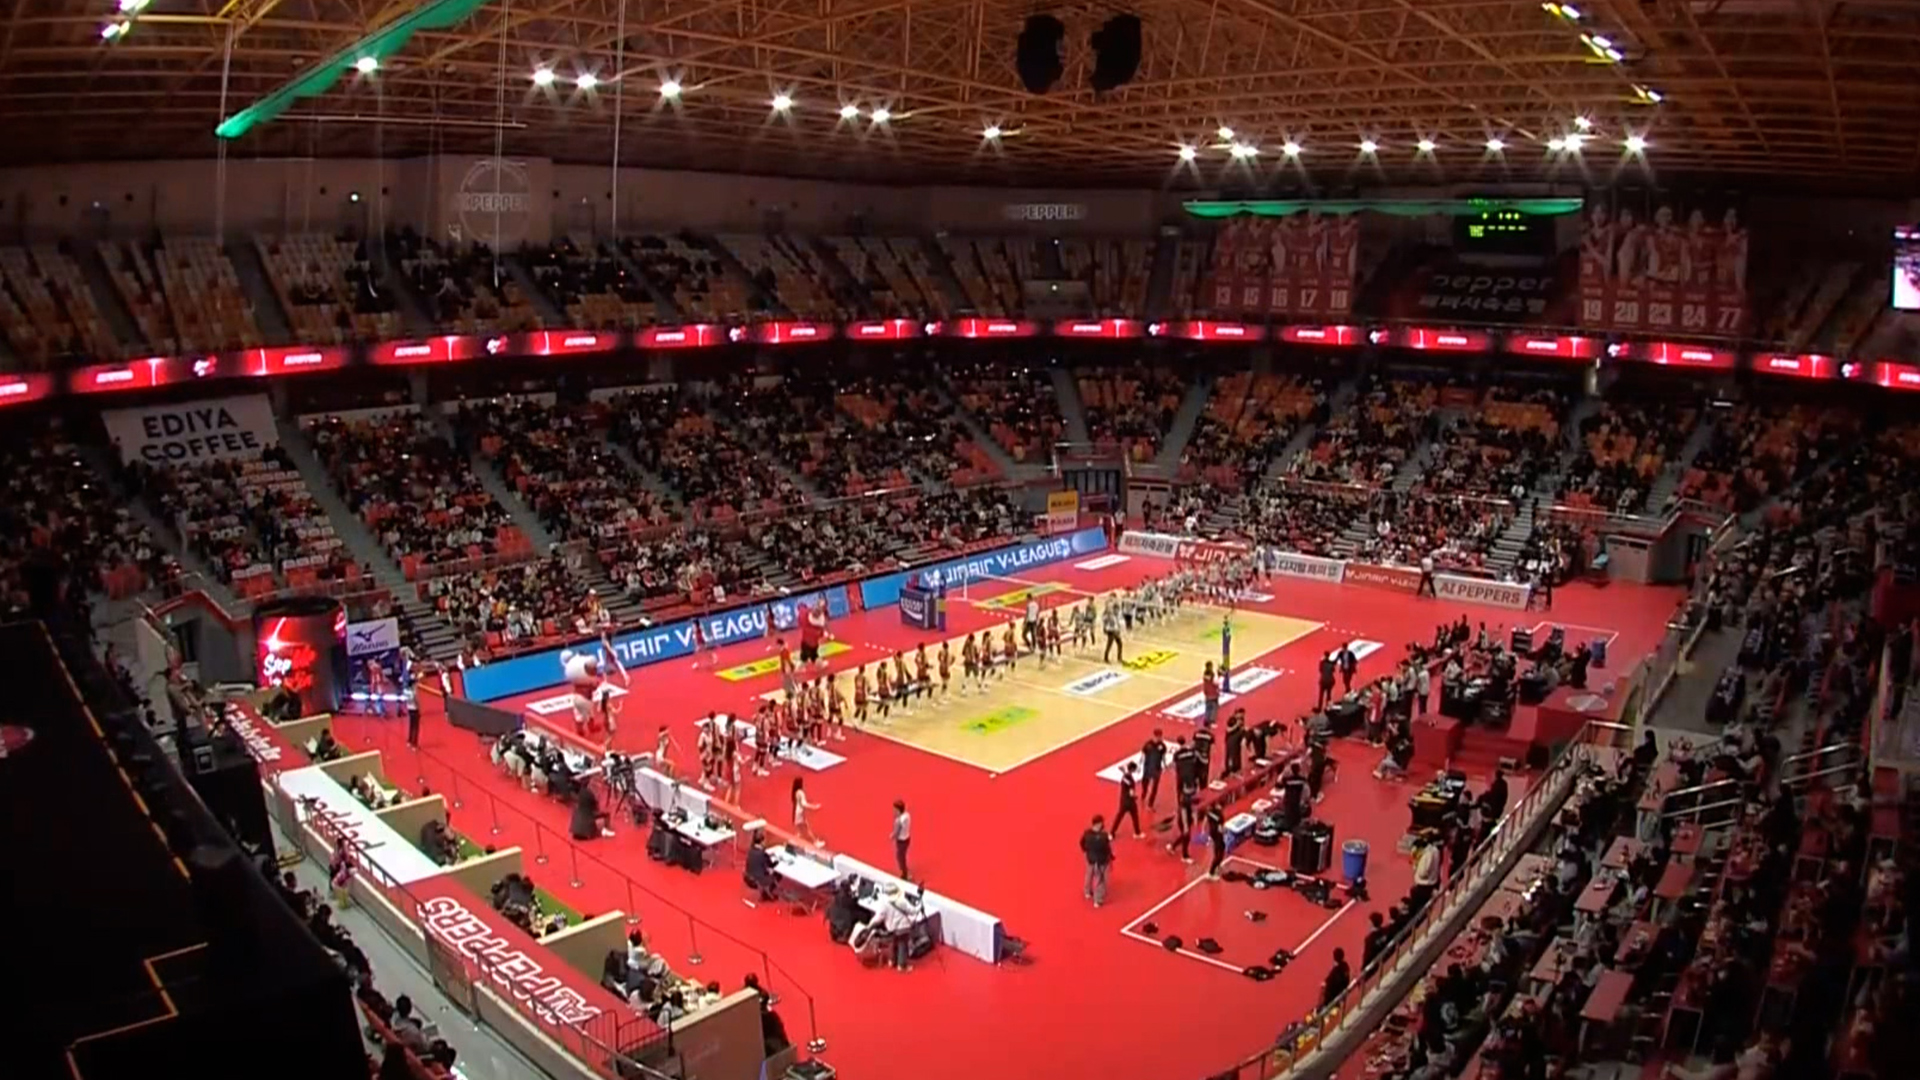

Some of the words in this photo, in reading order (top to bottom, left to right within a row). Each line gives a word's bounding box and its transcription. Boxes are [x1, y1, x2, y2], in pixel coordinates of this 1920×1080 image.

[1301, 289, 1318, 308] 17
[1614, 302, 1638, 322] 20
[1649, 304, 1672, 324] 23
[1682, 304, 1706, 326] 24
[1717, 307, 1742, 329] 77
[142, 407, 238, 438] EDIYA
[140, 431, 259, 462] COFFEE
[1440, 582, 1456, 594] AI
[1457, 585, 1520, 604] PEPPERS
